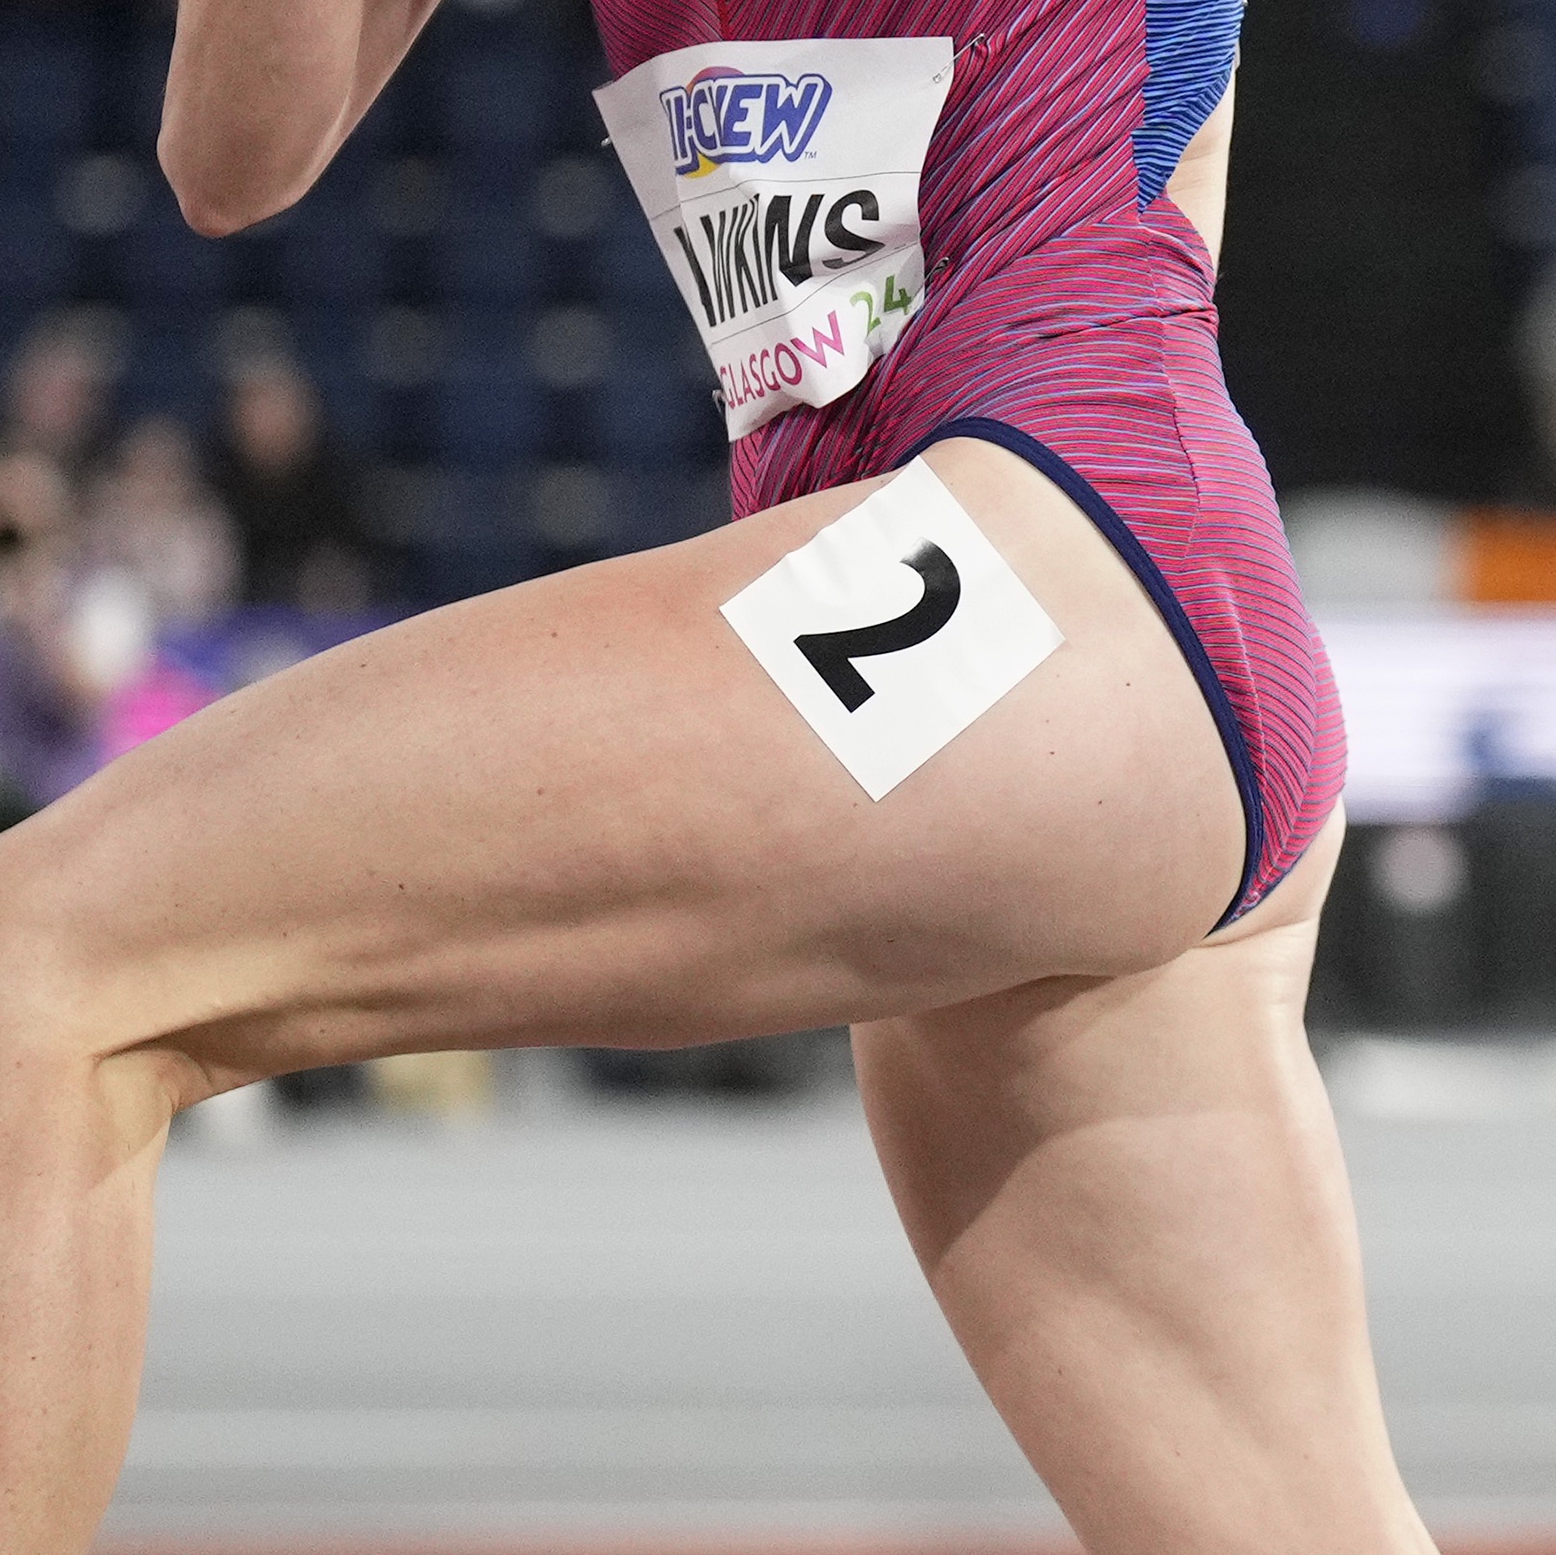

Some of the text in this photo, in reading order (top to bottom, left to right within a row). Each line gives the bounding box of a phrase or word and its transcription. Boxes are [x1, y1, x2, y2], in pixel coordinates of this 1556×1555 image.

[719, 274, 913, 410] GLASGOW 24
[793, 536, 962, 714] 2
